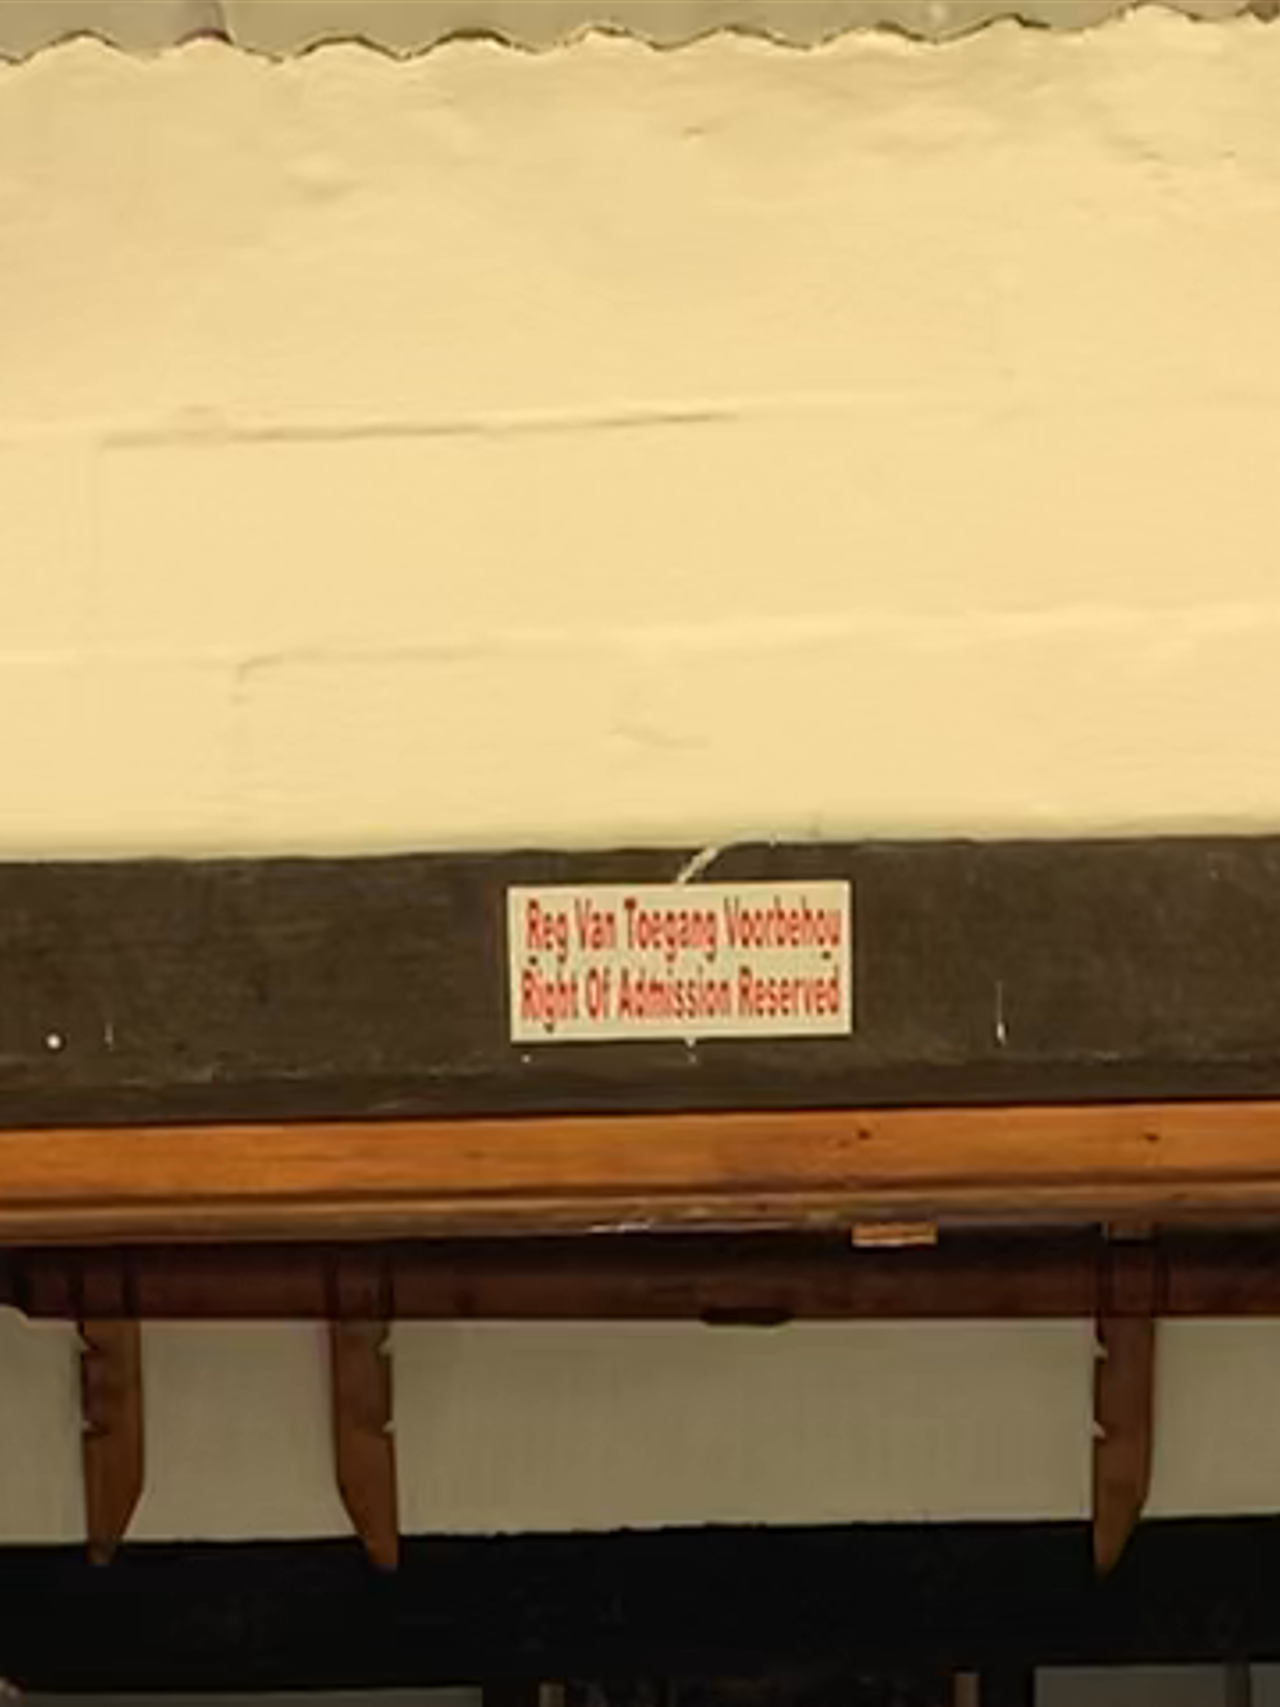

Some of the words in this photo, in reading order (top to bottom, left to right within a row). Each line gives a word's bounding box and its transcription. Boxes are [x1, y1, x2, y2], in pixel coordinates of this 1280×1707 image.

[526, 898, 568, 964] Reg
[574, 898, 618, 950] Van
[623, 897, 717, 963] Toegang
[723, 894, 841, 949] Voorbehou
[522, 966, 578, 1033] Right
[586, 966, 611, 1019] Of
[618, 966, 732, 1019] Admission
[738, 964, 840, 1017] Reserved
